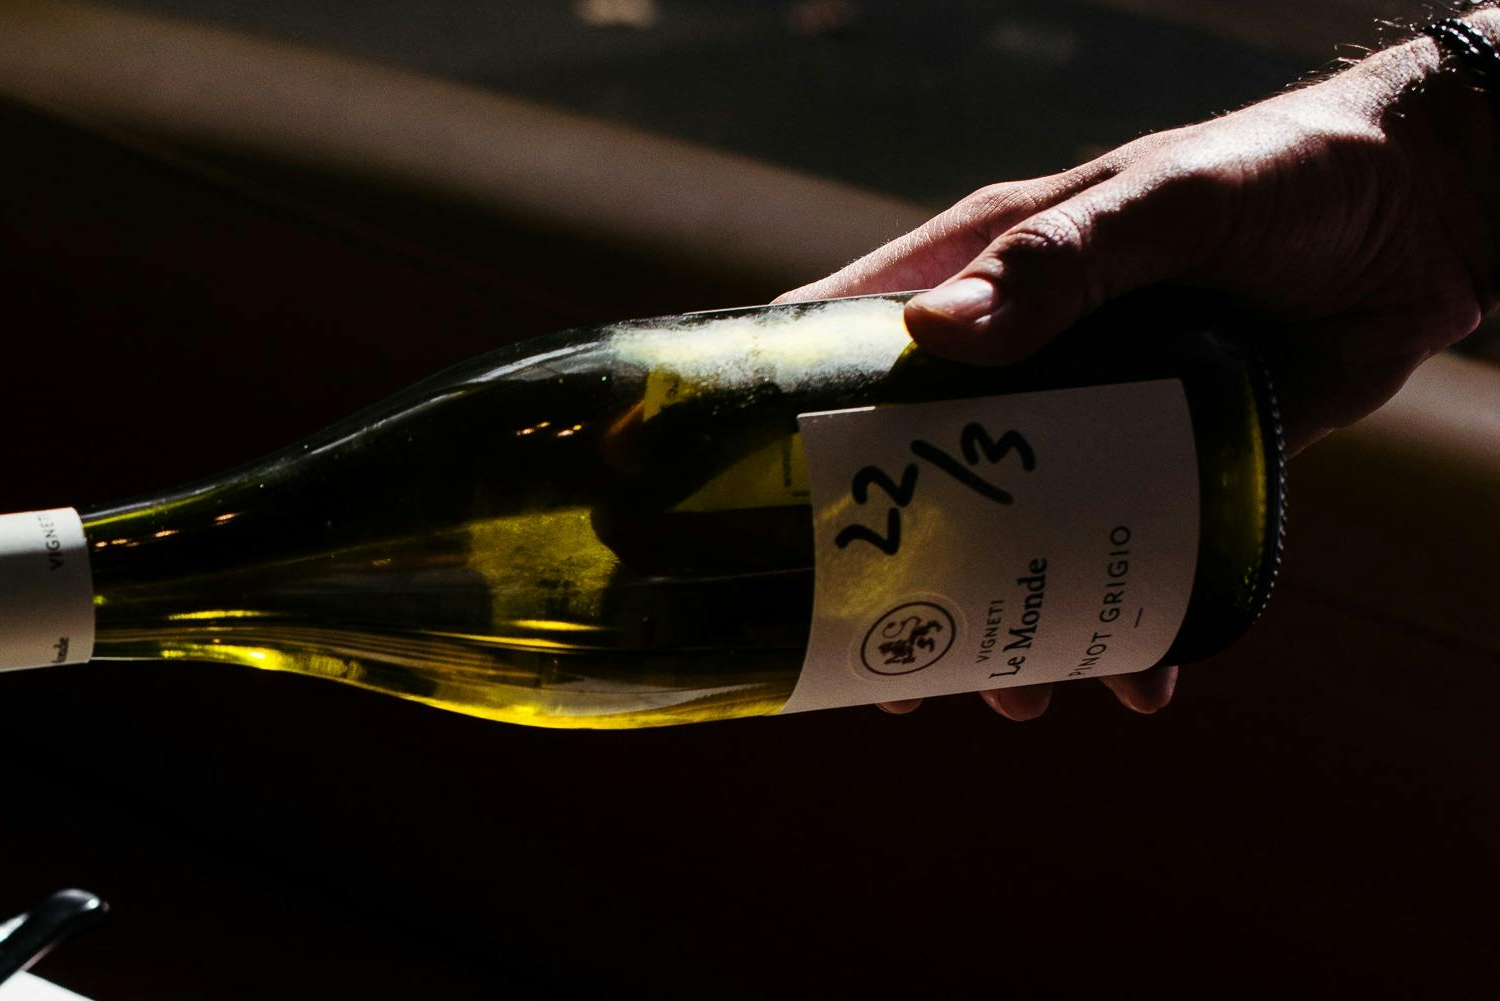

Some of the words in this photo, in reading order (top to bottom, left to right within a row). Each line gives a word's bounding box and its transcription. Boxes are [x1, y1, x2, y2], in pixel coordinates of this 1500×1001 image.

[835, 421, 1037, 557] 22/3
[976, 600, 1004, 664] VIGNETI
[1004, 558, 1048, 653] Monde
[1067, 631, 1113, 677] PINOT
[1099, 526, 1132, 623] GRIGIO
[988, 656, 1026, 680] Le
